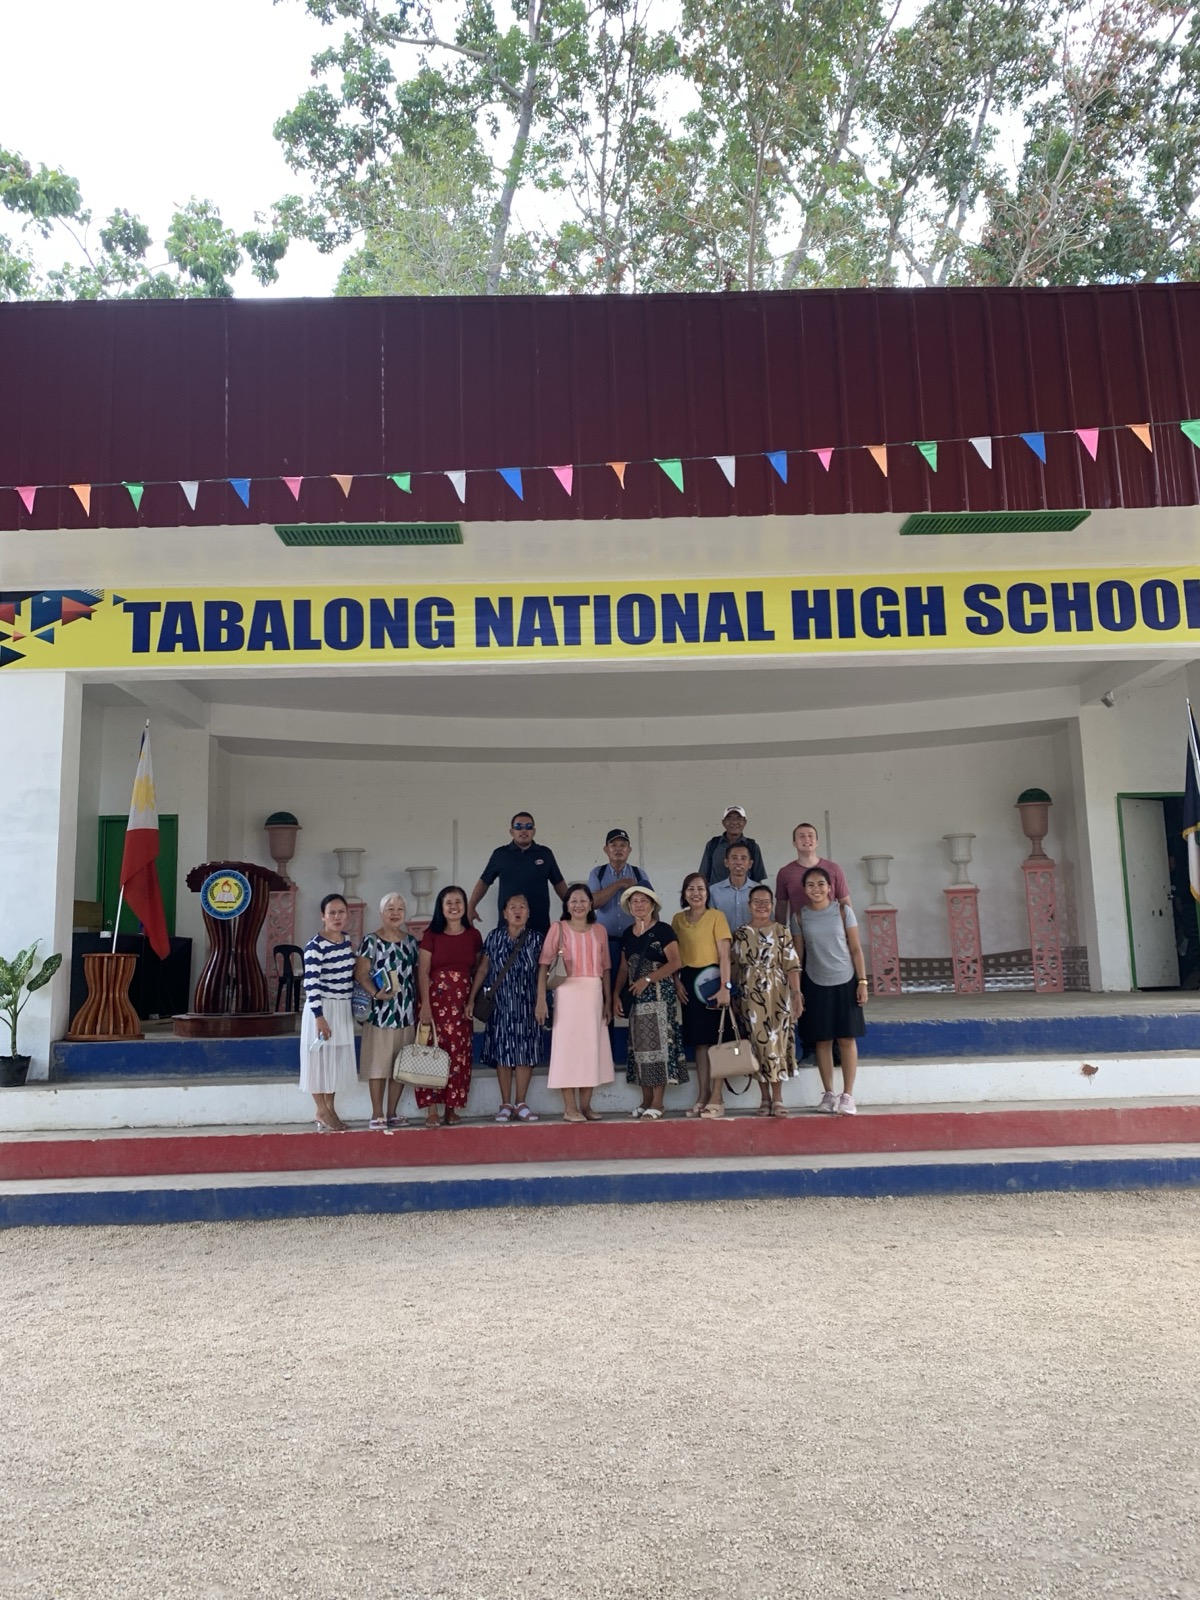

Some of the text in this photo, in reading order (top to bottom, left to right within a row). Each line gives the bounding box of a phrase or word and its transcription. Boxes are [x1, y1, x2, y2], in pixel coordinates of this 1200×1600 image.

[123, 597, 455, 653] TABALONG
[475, 591, 775, 648] NATIONAL
[791, 586, 947, 640] HIGH
